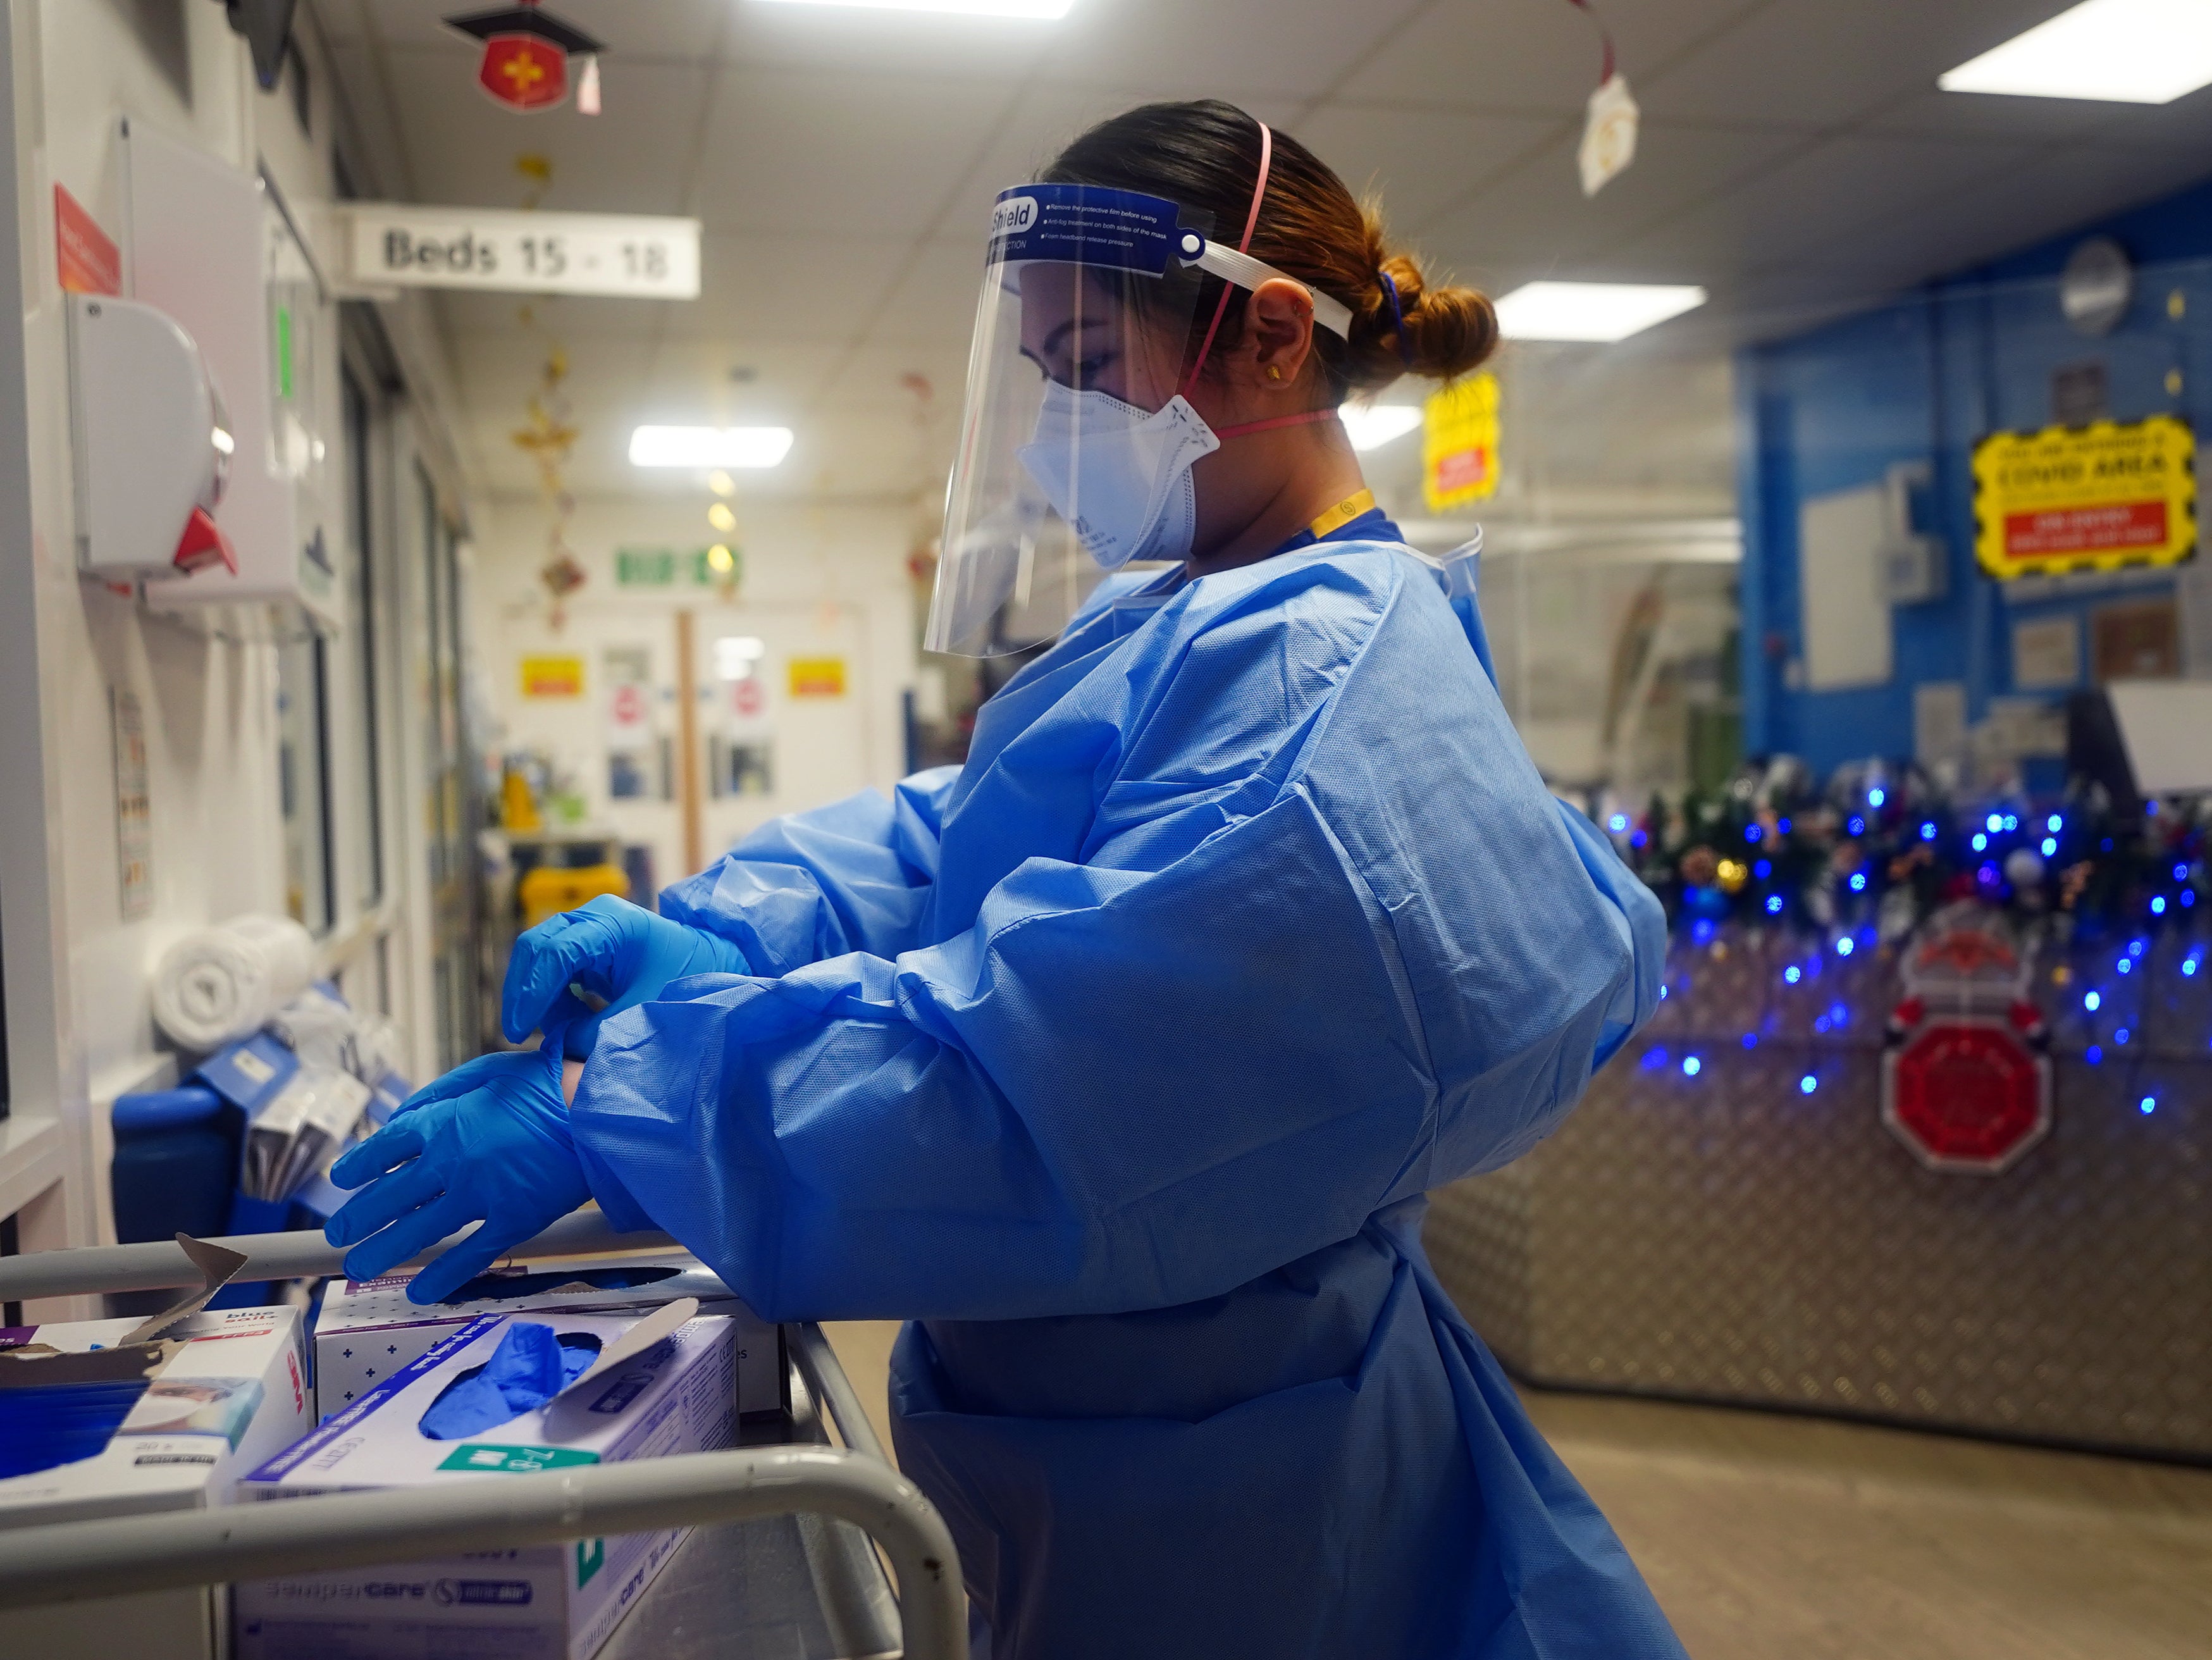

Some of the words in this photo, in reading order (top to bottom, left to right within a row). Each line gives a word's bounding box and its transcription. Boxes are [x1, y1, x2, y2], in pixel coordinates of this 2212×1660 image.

[992, 204, 1030, 232] Shield
[1141, 214, 1157, 223] using
[1116, 223, 1132, 232] sides
[1140, 228, 1150, 236] the
[1151, 232, 1168, 240] mask
[1108, 238, 1134, 247] pressure
[384, 227, 498, 273] Beds
[521, 235, 567, 278] 15
[622, 242, 668, 280] 18
[226, 1311, 275, 1319] blue
